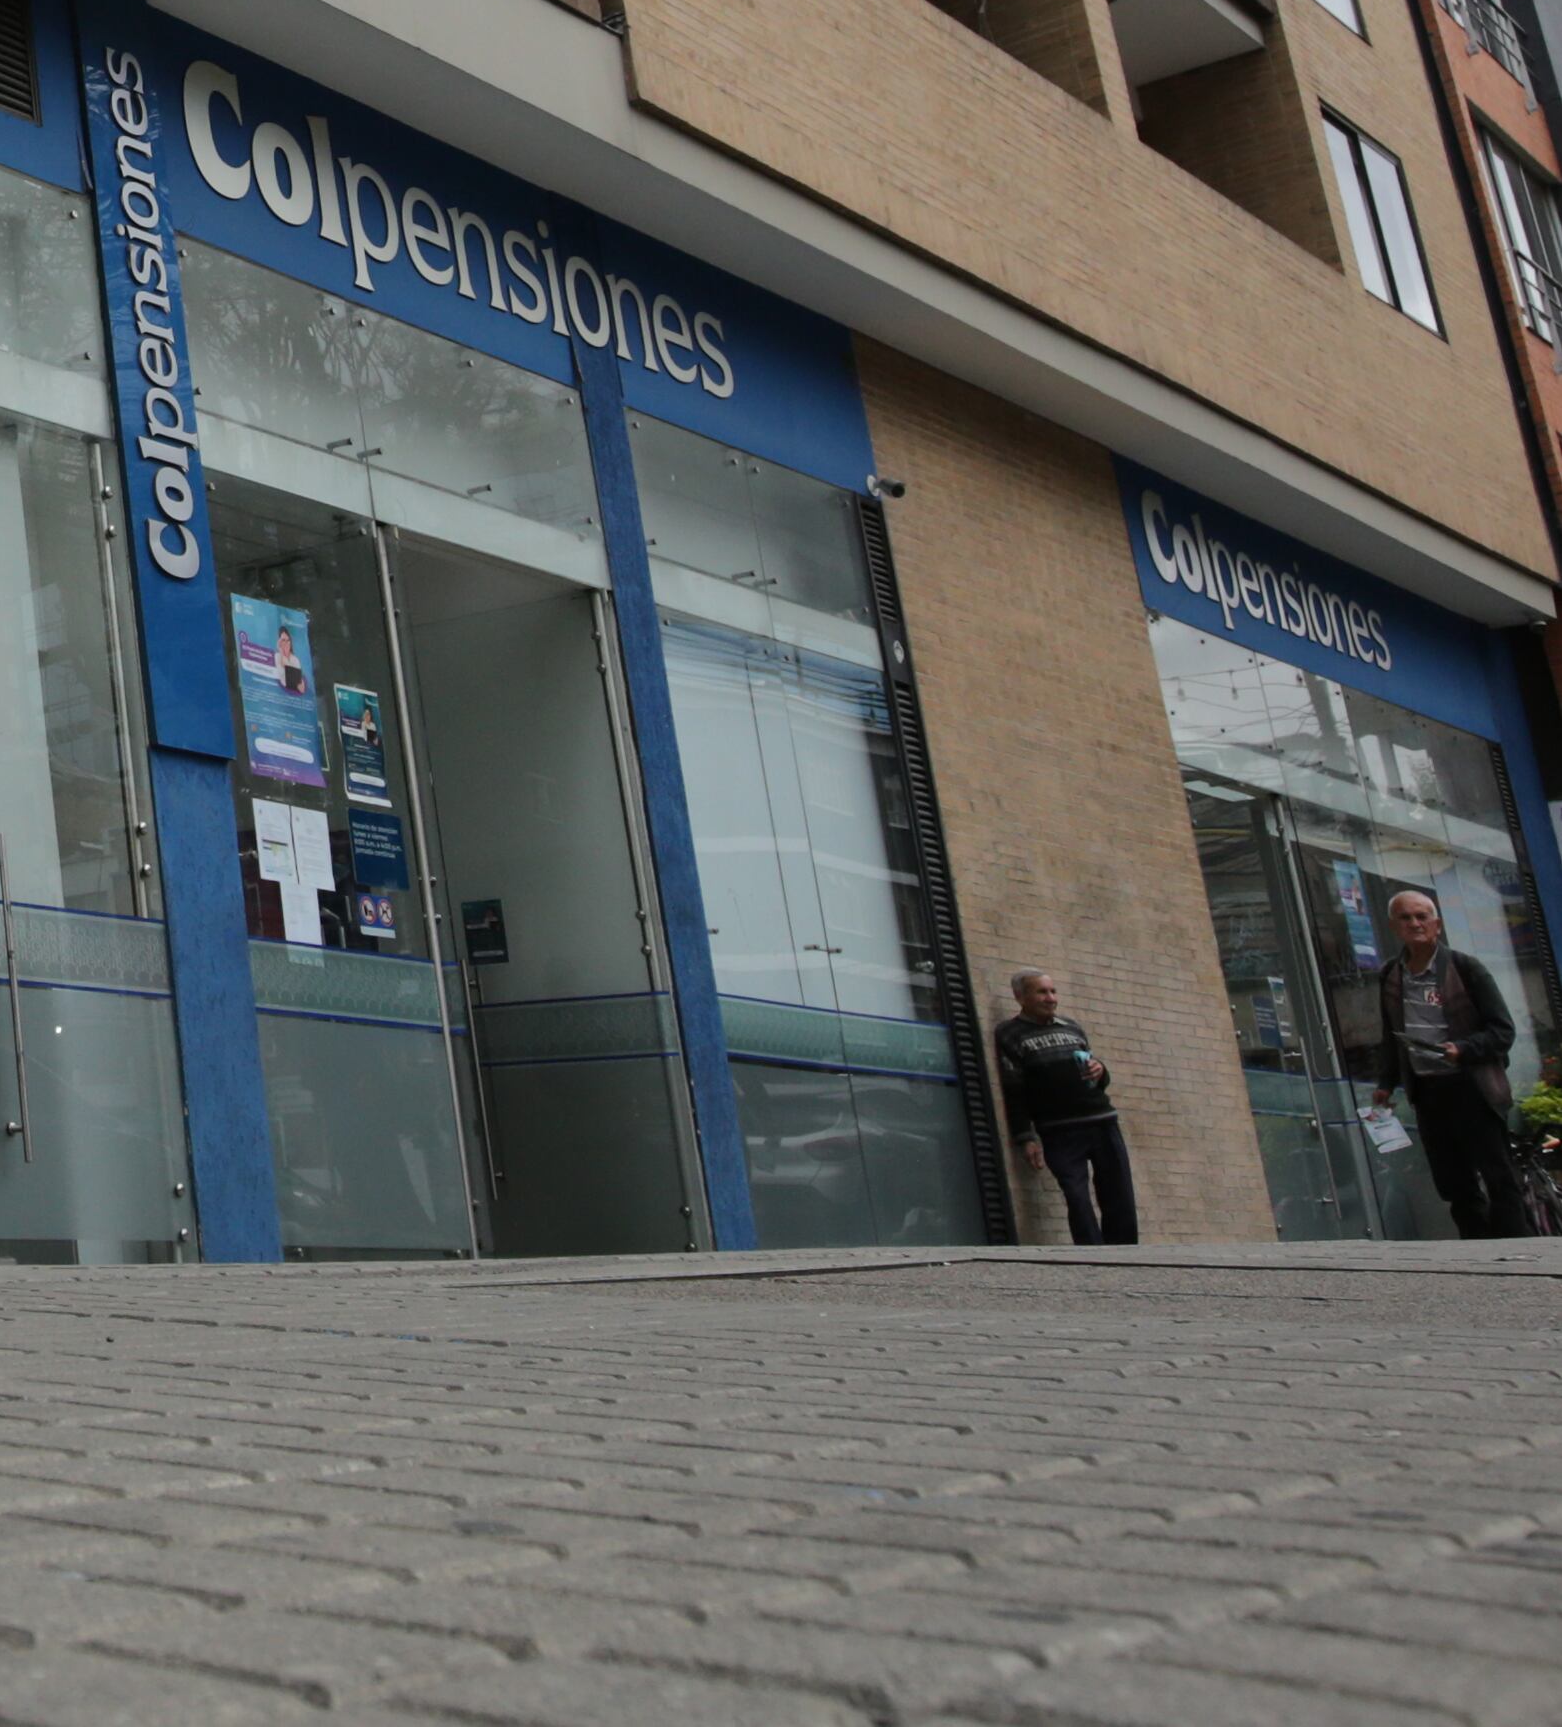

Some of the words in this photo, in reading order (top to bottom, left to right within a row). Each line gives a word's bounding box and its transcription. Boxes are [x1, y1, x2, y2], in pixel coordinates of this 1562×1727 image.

[105, 46, 200, 580] Colpensiones
[182, 59, 735, 400] Colpensiones
[1141, 489, 1392, 672] Colpensiones
